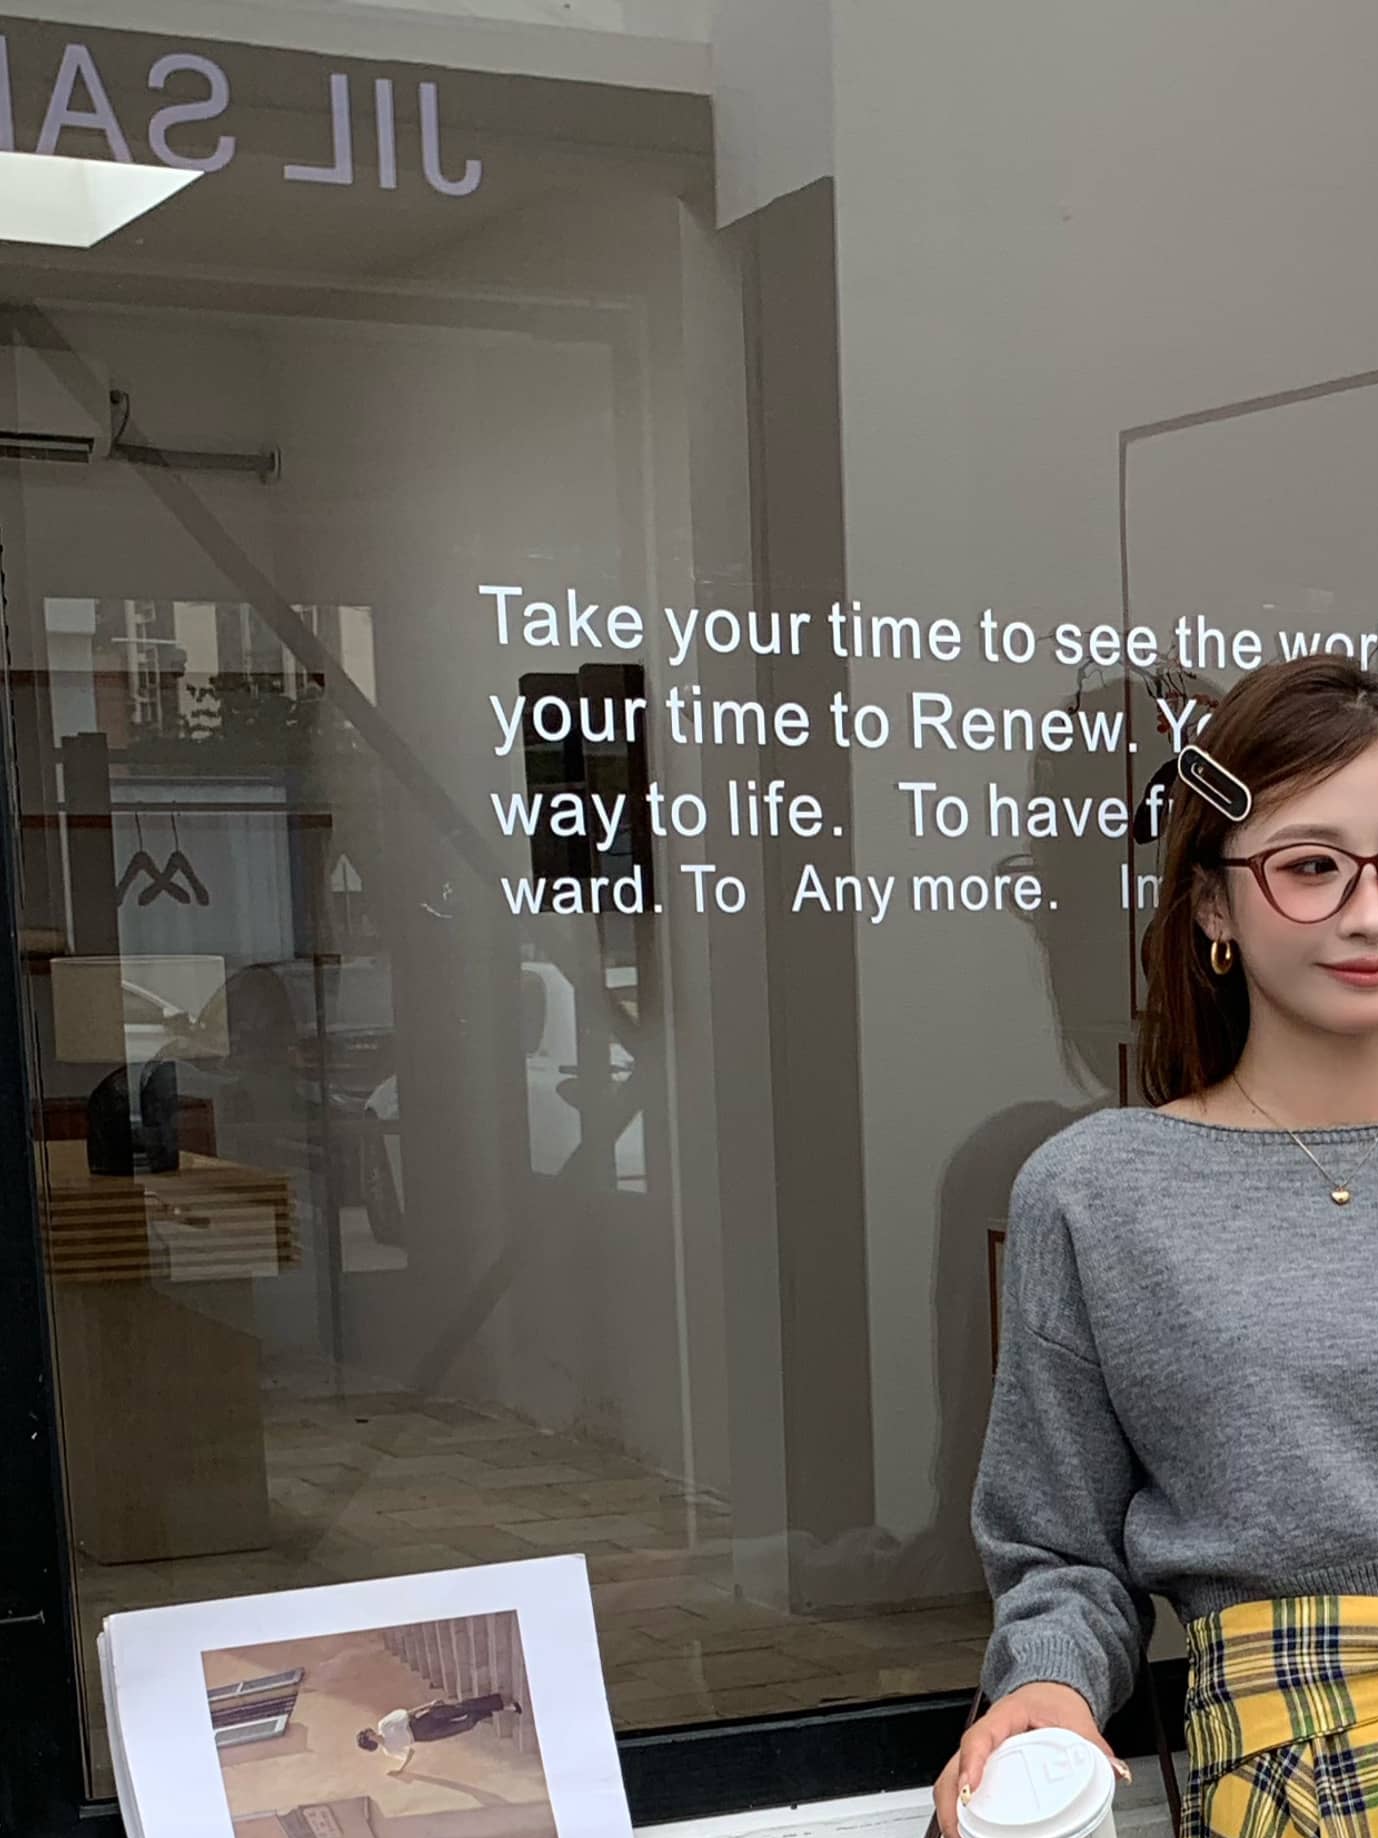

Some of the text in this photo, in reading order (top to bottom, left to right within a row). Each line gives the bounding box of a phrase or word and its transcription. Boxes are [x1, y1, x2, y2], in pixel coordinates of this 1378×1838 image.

[479, 585, 644, 648] Take
[665, 606, 811, 666] your
[829, 601, 961, 661] time
[981, 609, 1036, 663] to
[1056, 622, 1158, 667] see
[1176, 615, 1262, 669] the
[490, 694, 647, 756] your
[666, 685, 810, 746] time
[831, 692, 889, 748] to
[913, 692, 1137, 752] Renew.
[491, 794, 626, 851] way
[647, 782, 706, 836] to
[729, 780, 844, 837] life.
[899, 782, 969, 837] To
[990, 783, 1128, 837] have
[501, 863, 662, 914] ward.
[681, 865, 745, 912] To
[793, 865, 895, 923] Any
[913, 875, 1058, 911] more.
